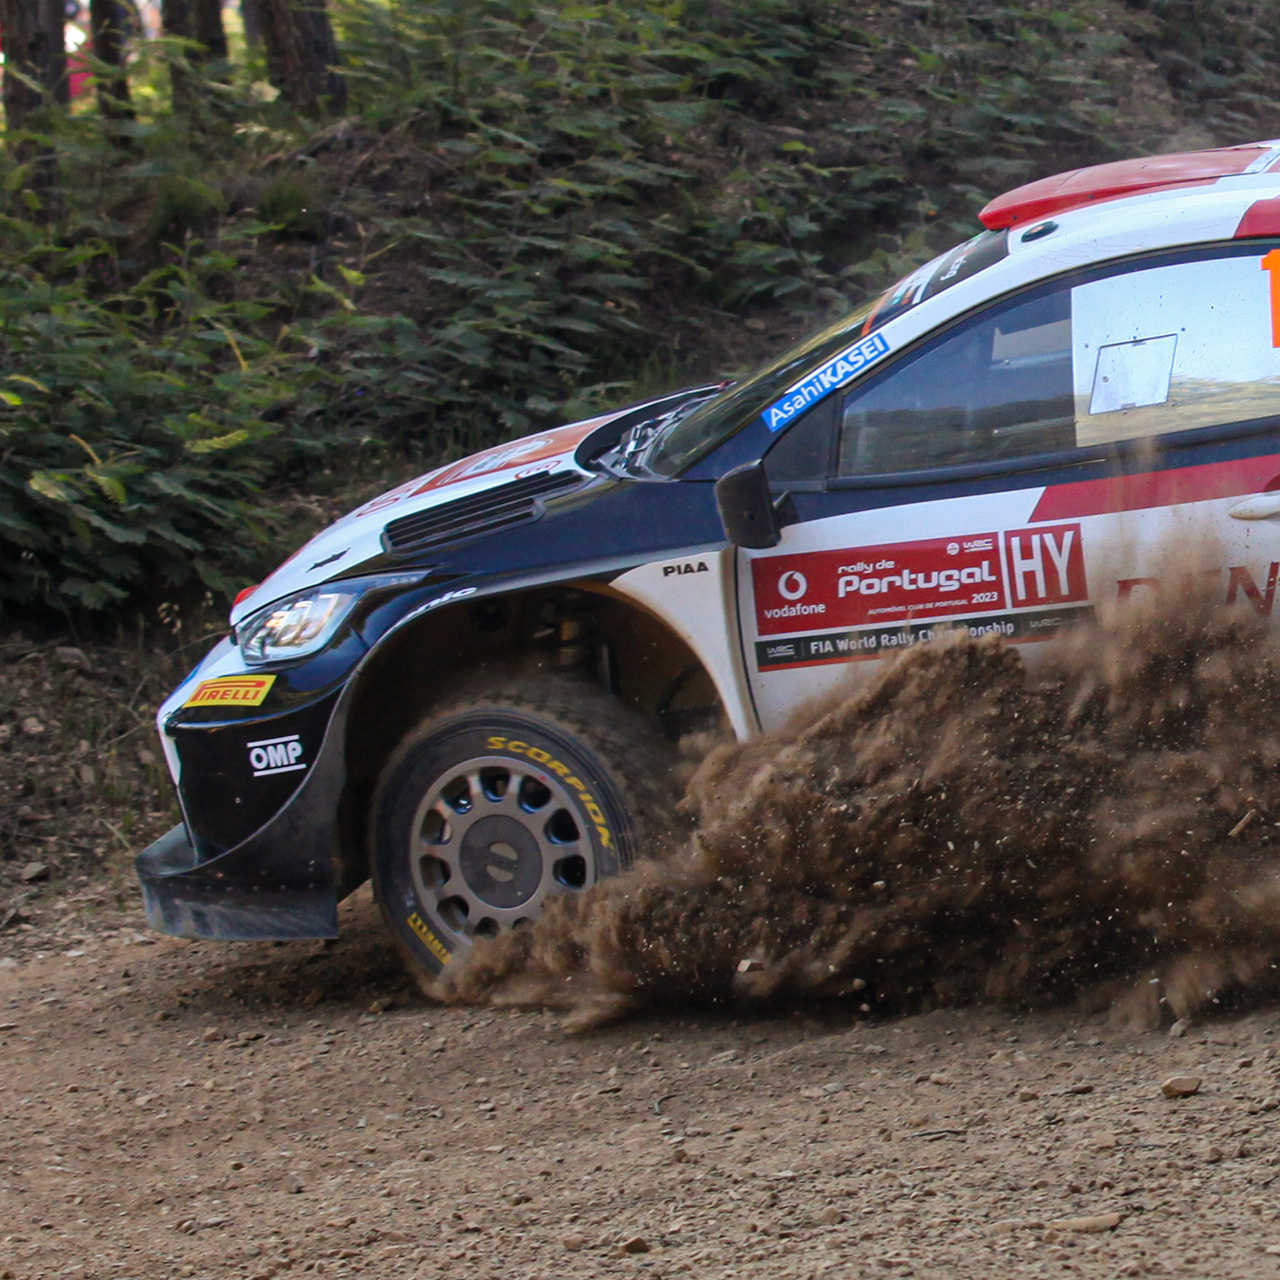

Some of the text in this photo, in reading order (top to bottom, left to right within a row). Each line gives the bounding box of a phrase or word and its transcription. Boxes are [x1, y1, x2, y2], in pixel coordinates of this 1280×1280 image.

[663, 561, 710, 577] PIAA
[838, 560, 895, 574] rally de
[1010, 530, 1075, 601] HY
[838, 560, 997, 598] Portugal
[934, 599, 969, 608] PORTUGAL
[971, 591, 998, 604] 2023
[764, 602, 826, 619] vodafone
[810, 641, 834, 655] FIA
[835, 634, 877, 651] World
[881, 632, 915, 648] Rally
[190, 680, 267, 702] PIRELLI
[250, 741, 303, 770] OMP
[486, 736, 617, 858] SCORPION
